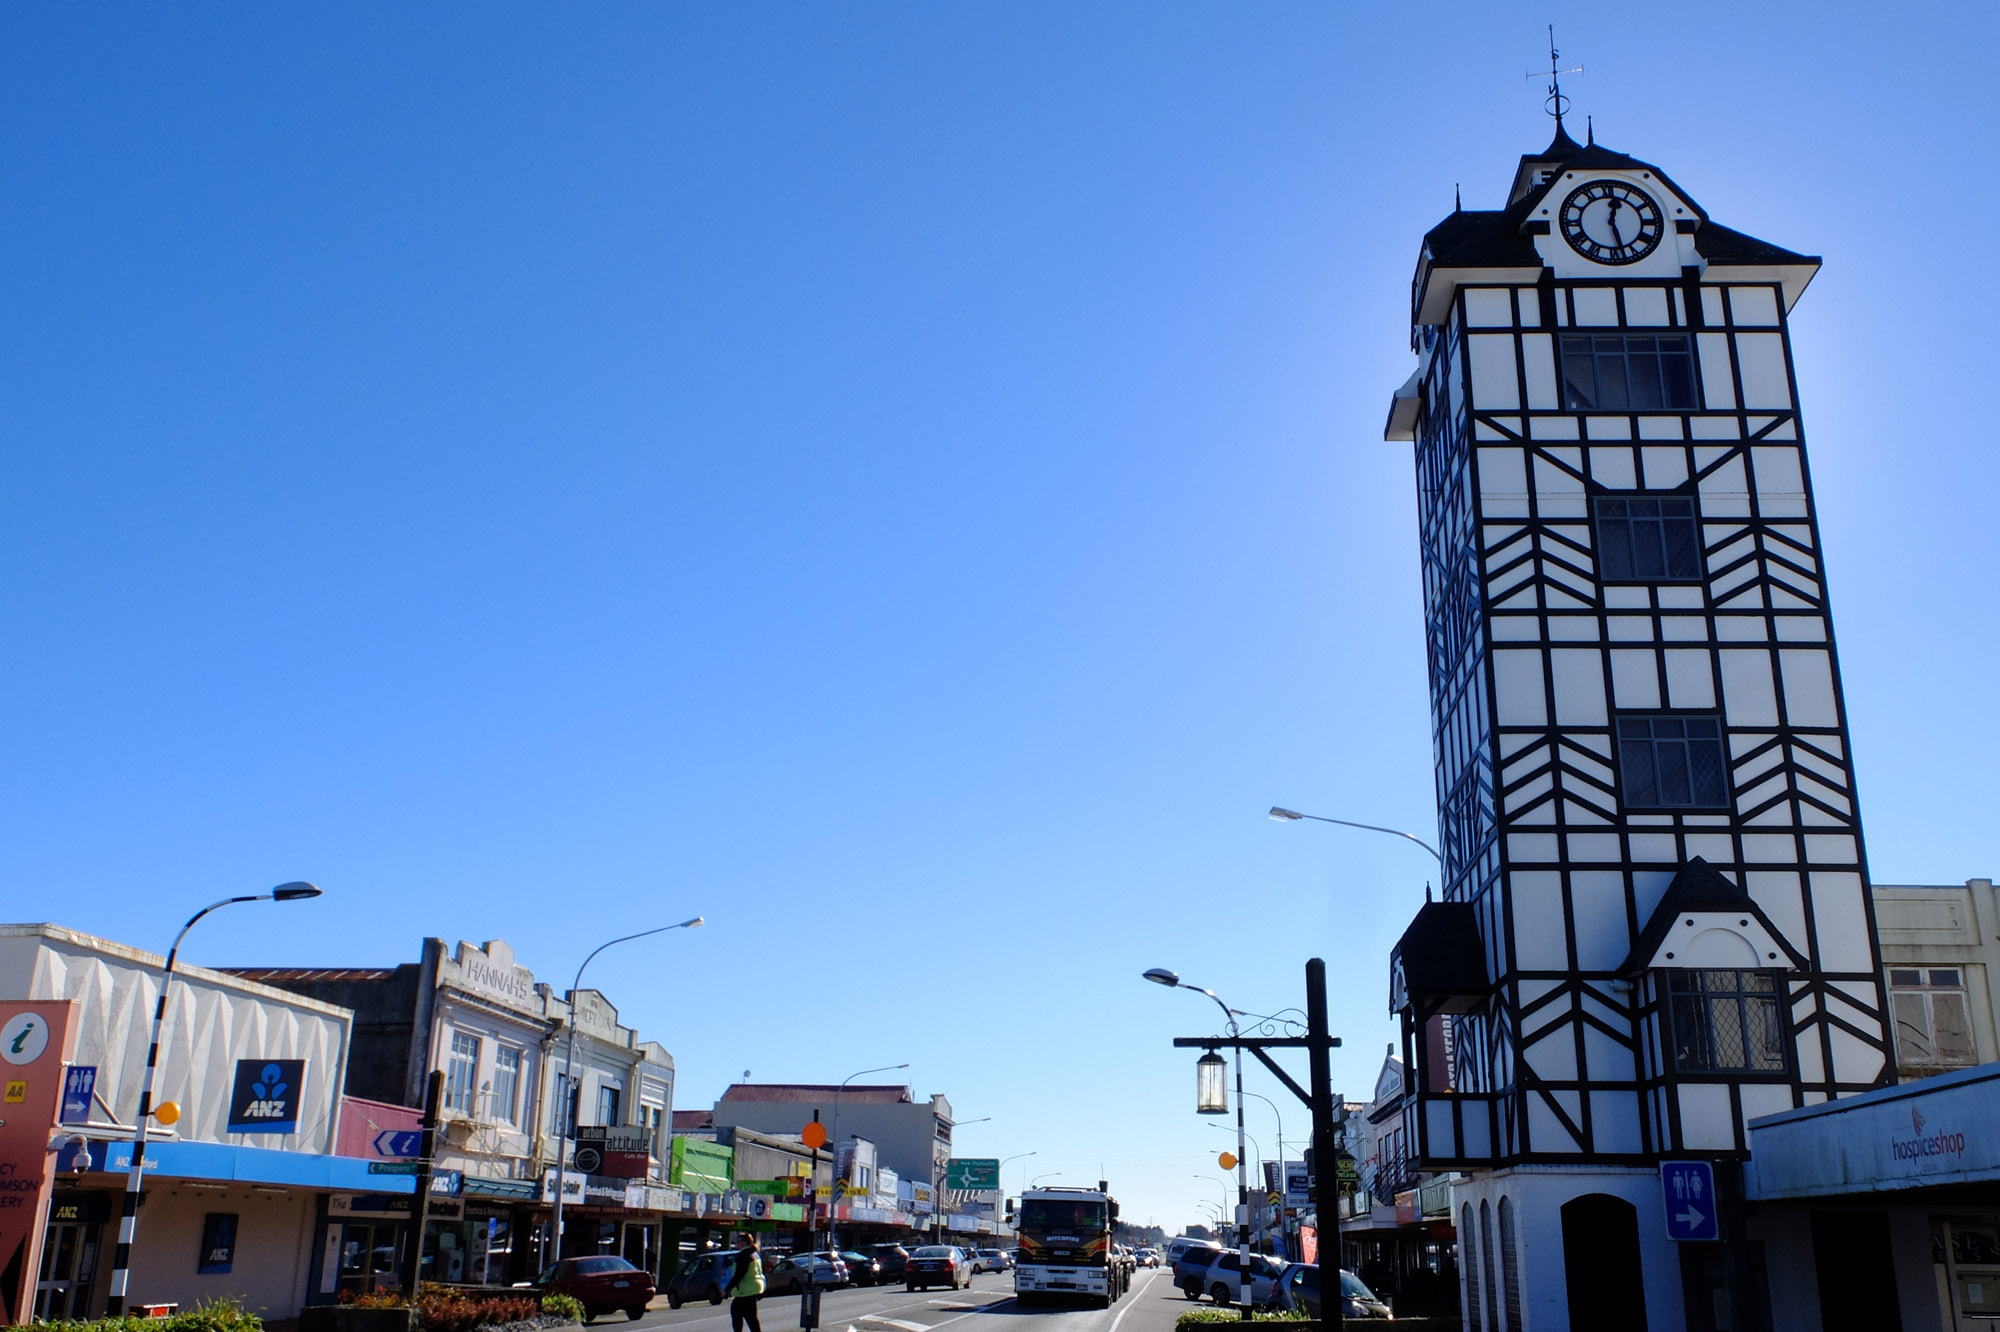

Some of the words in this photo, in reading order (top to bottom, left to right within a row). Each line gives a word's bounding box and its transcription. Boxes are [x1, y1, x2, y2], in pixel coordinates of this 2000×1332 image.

[467, 959, 527, 1000] HANNAHS
[6, 1085, 24, 1097] AA
[243, 1100, 286, 1118] ANZ
[582, 1128, 605, 1138] urban
[606, 1127, 649, 1151] attitude
[1891, 1128, 1965, 1165] hospiceshop
[114, 1156, 130, 1167] ANZ
[430, 1176, 450, 1192] ANZ
[1343, 1182, 1352, 1191] 7
[55, 1205, 79, 1219] ANZ
[208, 1248, 229, 1261] ANZ
